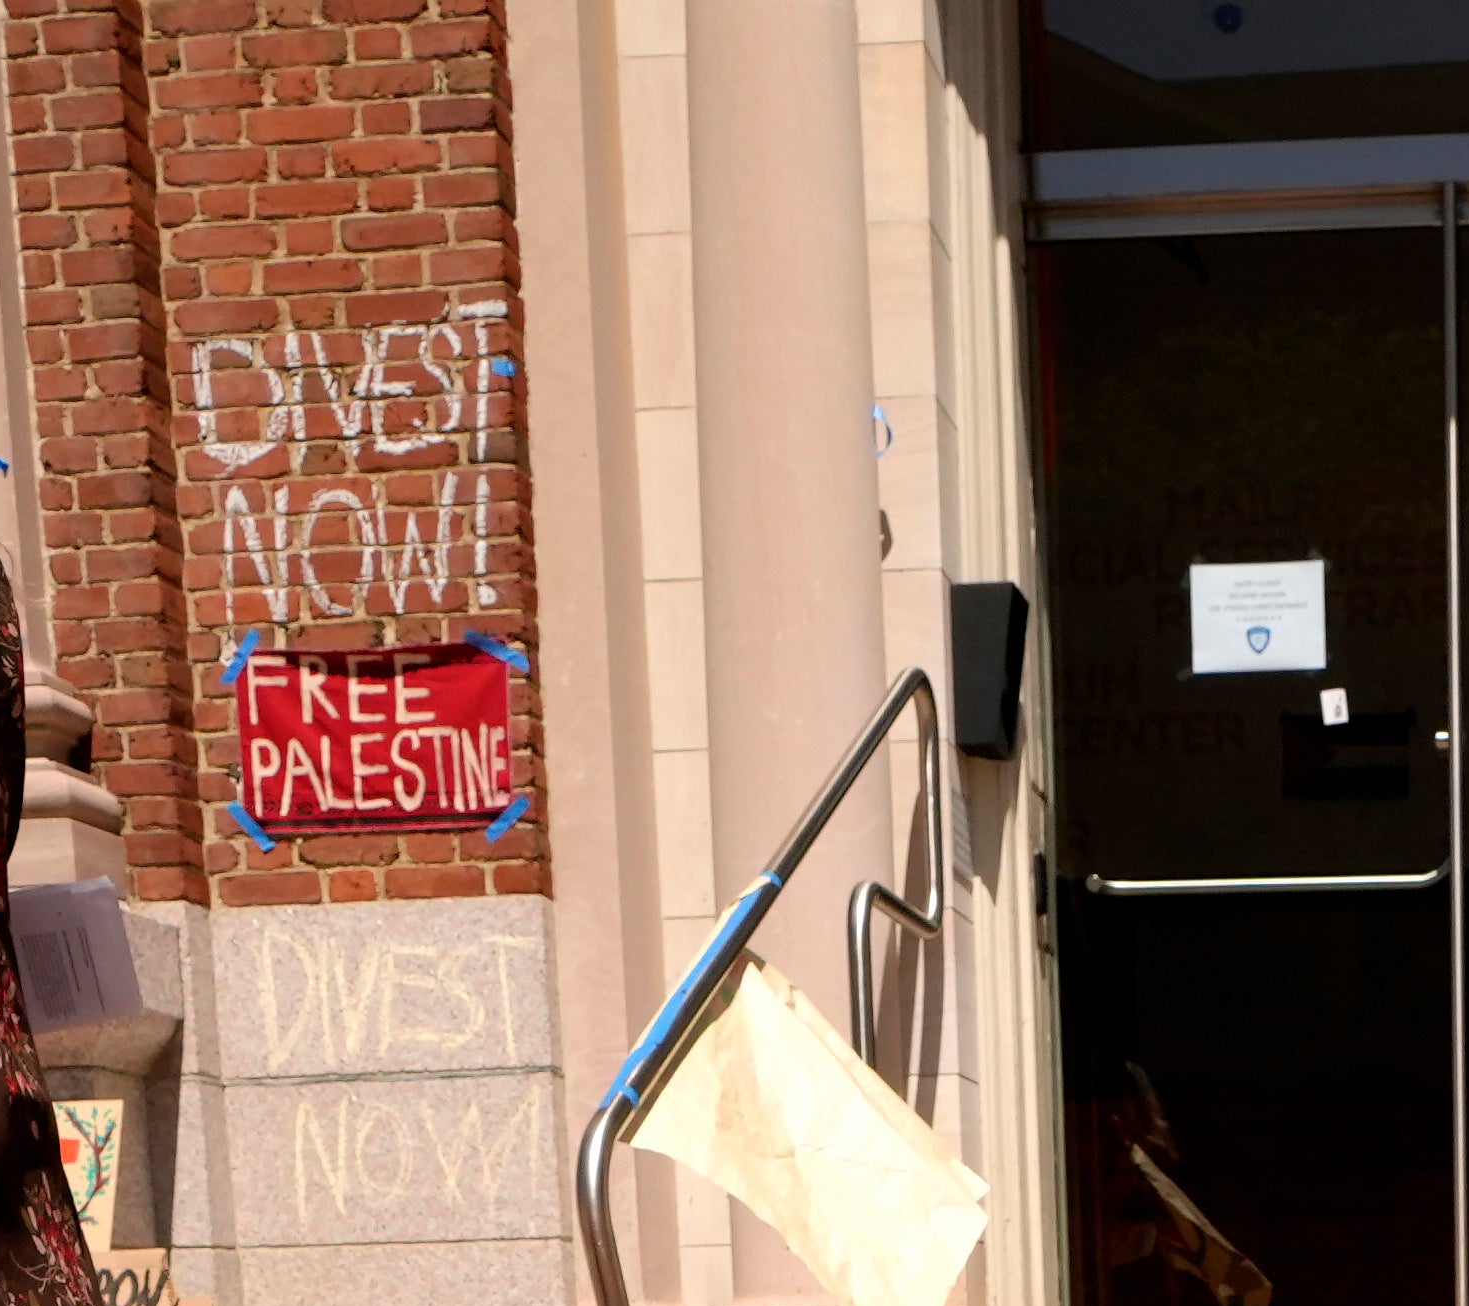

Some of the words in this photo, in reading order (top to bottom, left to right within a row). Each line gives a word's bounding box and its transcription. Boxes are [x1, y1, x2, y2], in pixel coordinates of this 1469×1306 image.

[192, 300, 508, 466] DIVEST
[223, 472, 499, 624] NOW!
[246, 654, 437, 724] FREE
[250, 724, 511, 818] PALESTINE
[256, 925, 537, 1070] DIVEST
[293, 1094, 539, 1225] NOW
